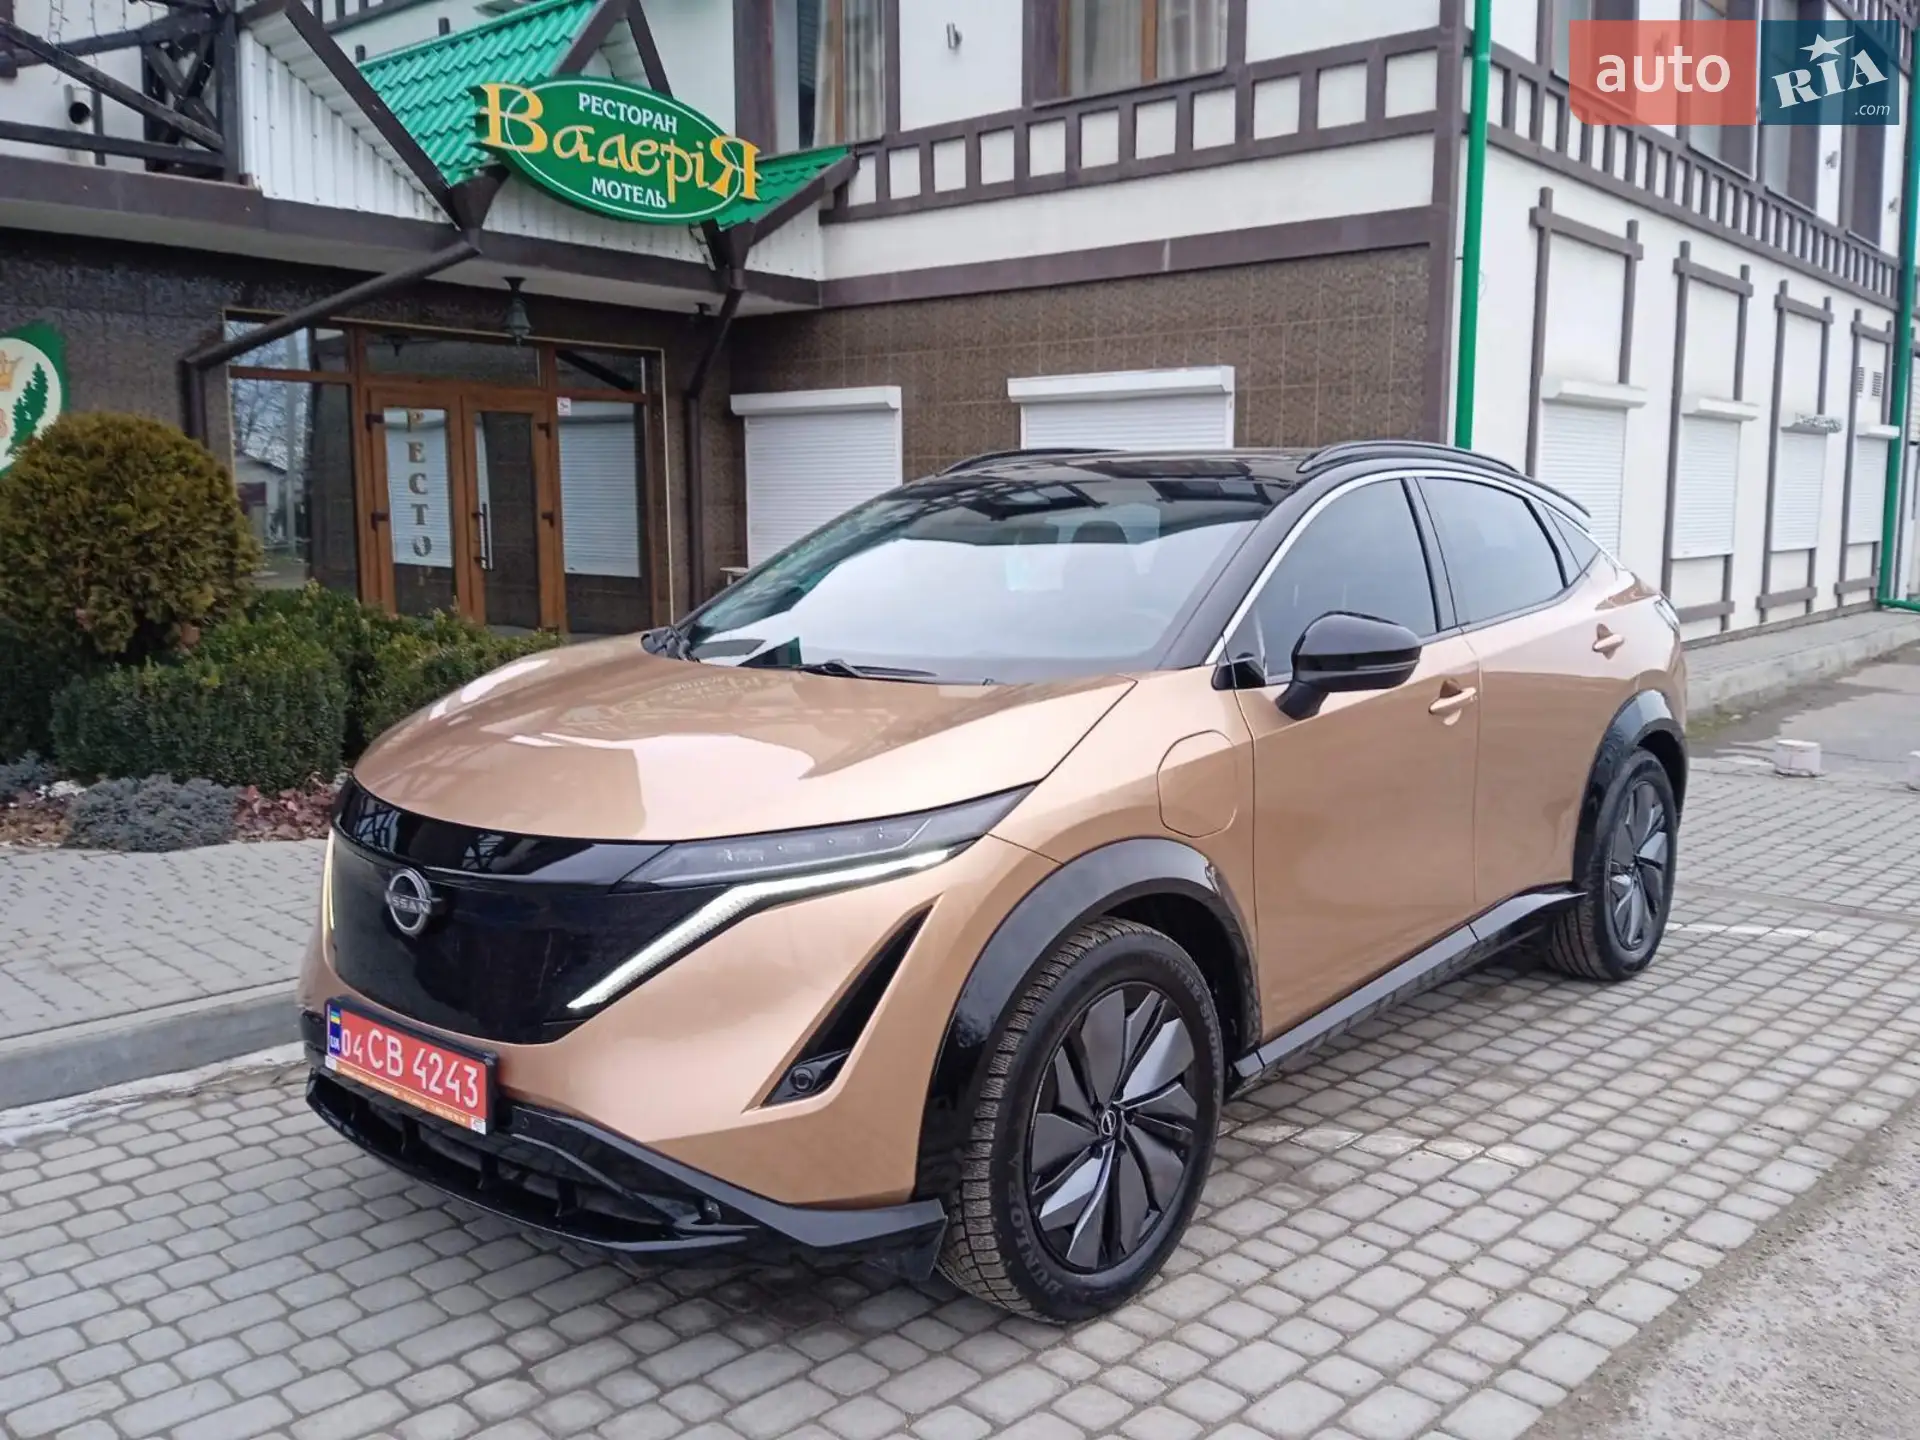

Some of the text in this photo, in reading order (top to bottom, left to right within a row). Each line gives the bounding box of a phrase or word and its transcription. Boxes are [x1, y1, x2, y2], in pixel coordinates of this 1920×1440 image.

[578, 92, 678, 135] РЕСТОРАН
[591, 177, 668, 209] МОТЕЛЬ
[413, 1047, 479, 1109] 4243
